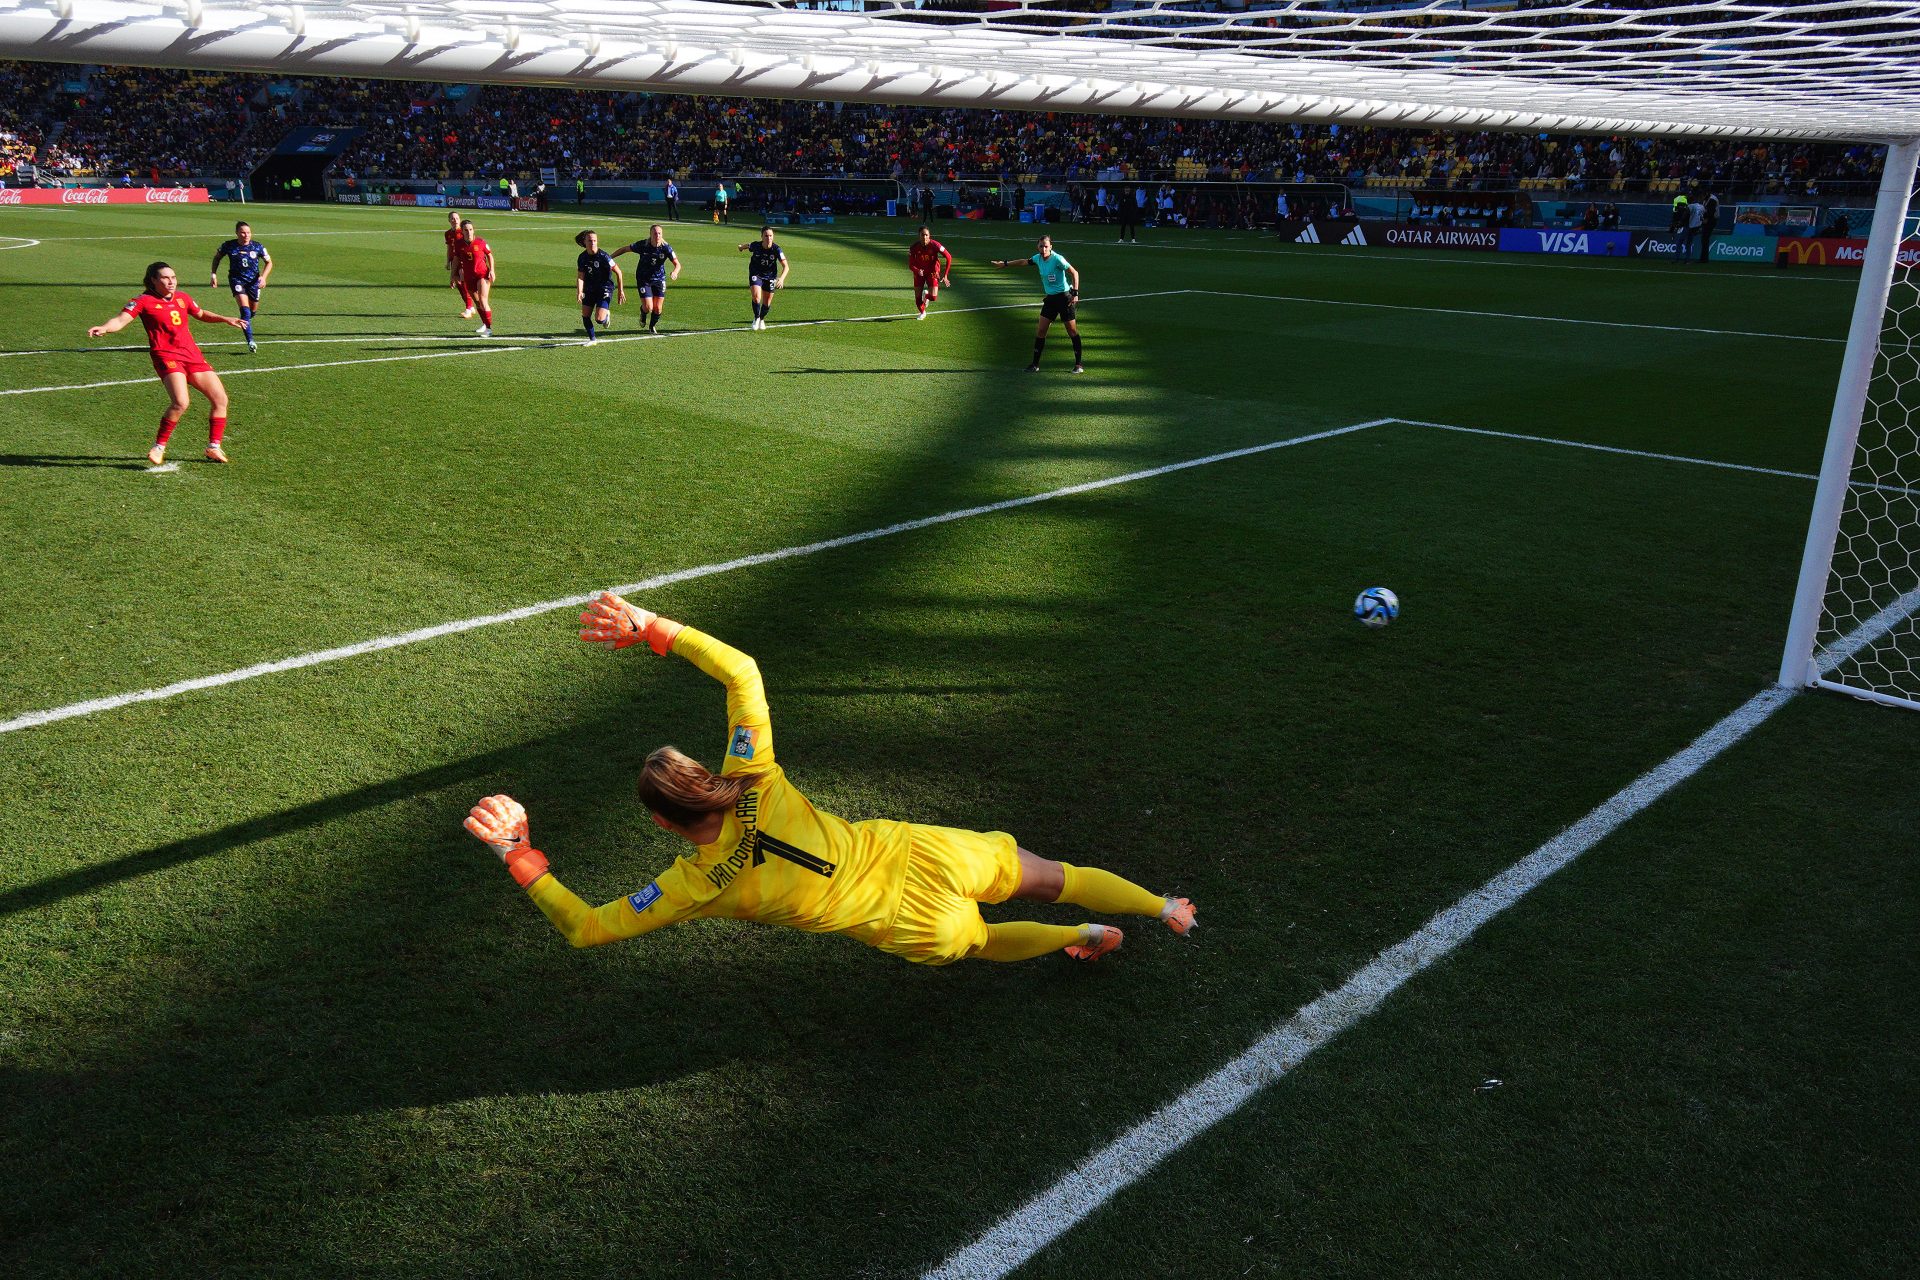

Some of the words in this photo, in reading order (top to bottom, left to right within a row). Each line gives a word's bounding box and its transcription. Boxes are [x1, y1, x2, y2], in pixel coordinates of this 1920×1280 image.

[62, 188, 110, 204] Coca-Cola
[145, 188, 191, 203] Coca-Cola
[1386, 229, 1432, 244] QATAR
[1435, 231, 1497, 246] AIRWAYS
[1536, 231, 1590, 253] VISA
[1648, 239, 1694, 253] Rexo
[1716, 239, 1764, 257] Rexona
[241, 258, 249, 268] 8
[170, 310, 182, 326] 8
[751, 828, 837, 879] 1
[706, 862, 738, 890] VAN
